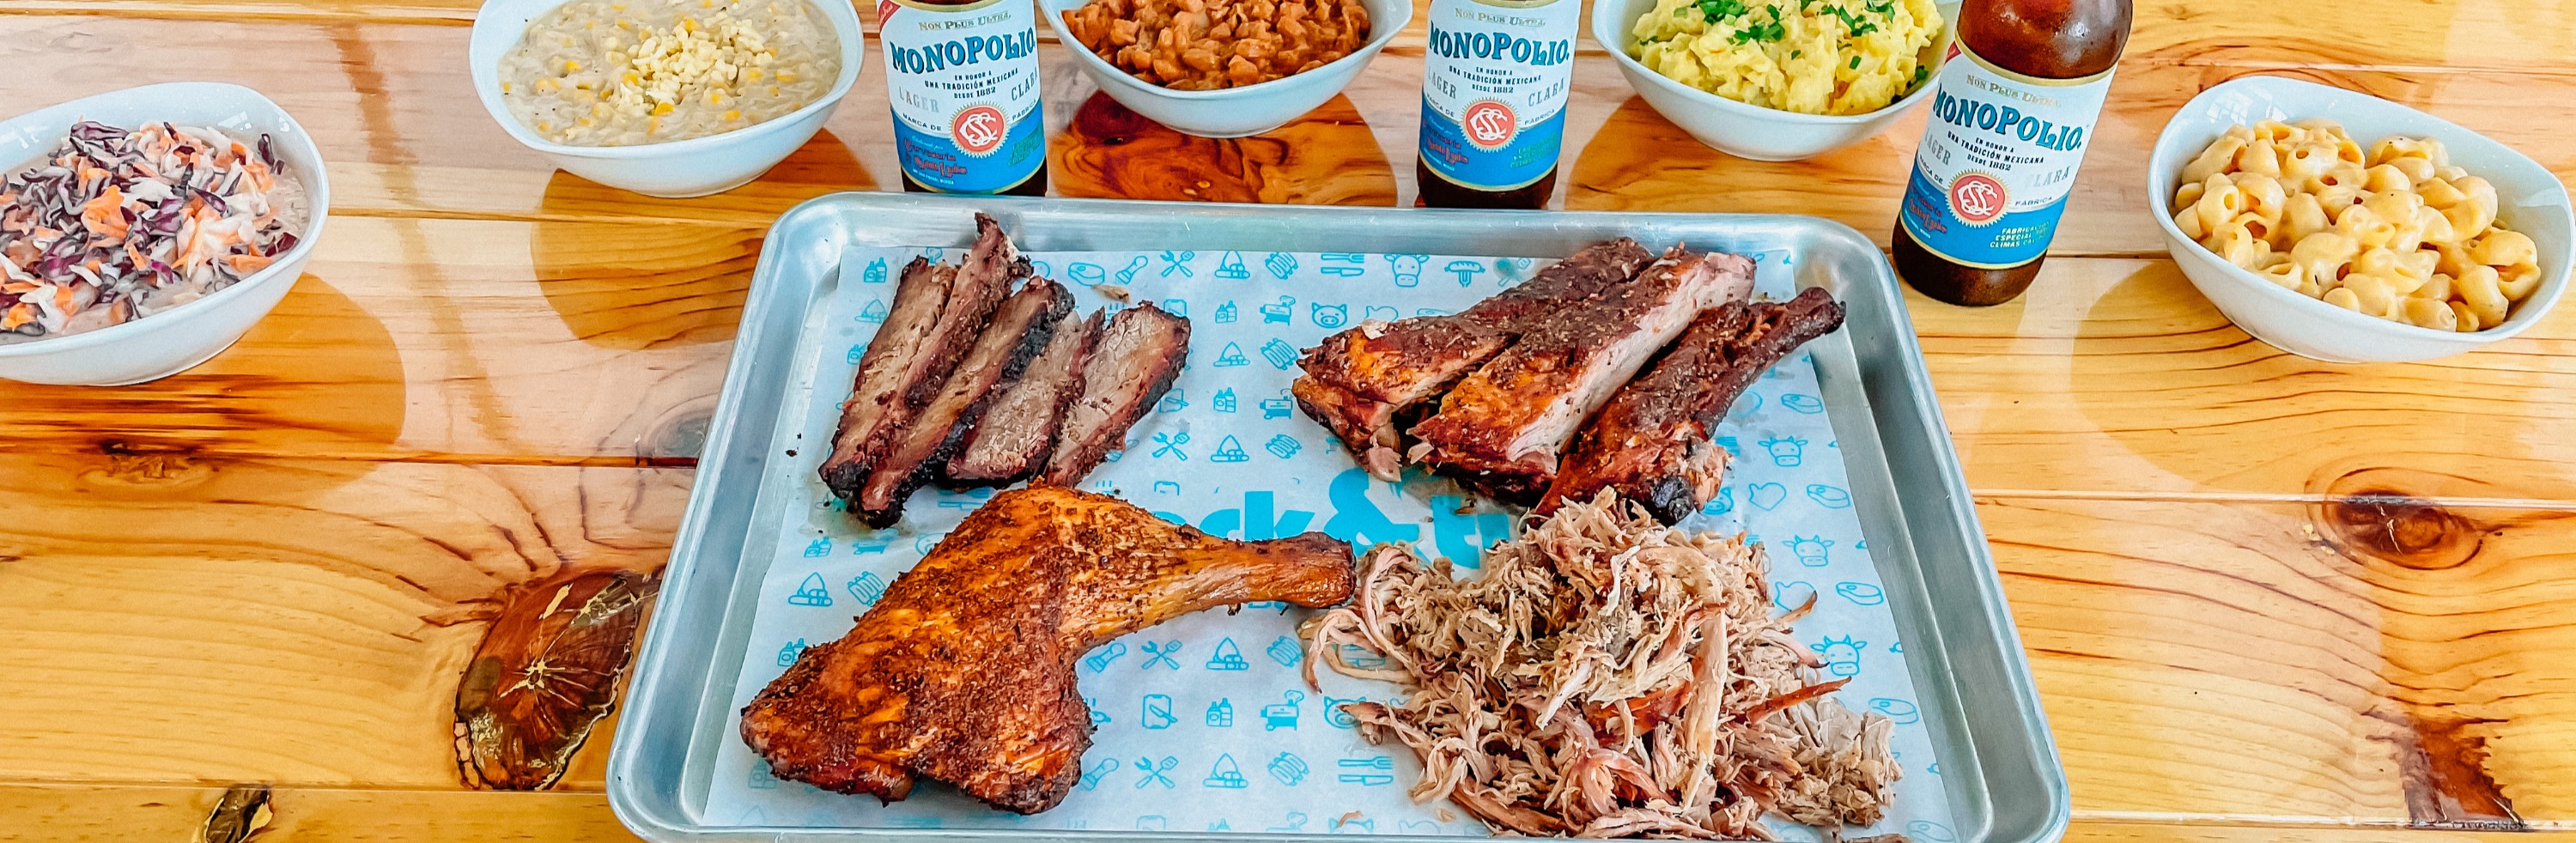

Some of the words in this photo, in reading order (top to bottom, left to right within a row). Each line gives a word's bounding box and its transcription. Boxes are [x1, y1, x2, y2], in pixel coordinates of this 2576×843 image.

[942, 78, 984, 90] TRADICIÓN
[987, 67, 1018, 85] MEXICANA
[965, 71, 986, 81] HONOR
[1463, 70, 1502, 85] TRADICIÓN
[1505, 74, 1542, 86] MEXICANA
[1486, 68, 1507, 76] HONOR
[898, 86, 940, 113] LAGER
[1528, 77, 1564, 107] CLARA
[1947, 130, 1959, 143] UNA
[1961, 139, 2001, 161] TRADICIÓN
[2003, 155, 2044, 164] MEXICANA
[1985, 141, 2008, 152] HONOR
[1967, 154, 1986, 166] DESDE
[1989, 161, 2011, 171] 1882
[1934, 174, 1943, 185] DE
[2026, 166, 2070, 187] LARA
[1995, 233, 2032, 241] ESPECIAL
